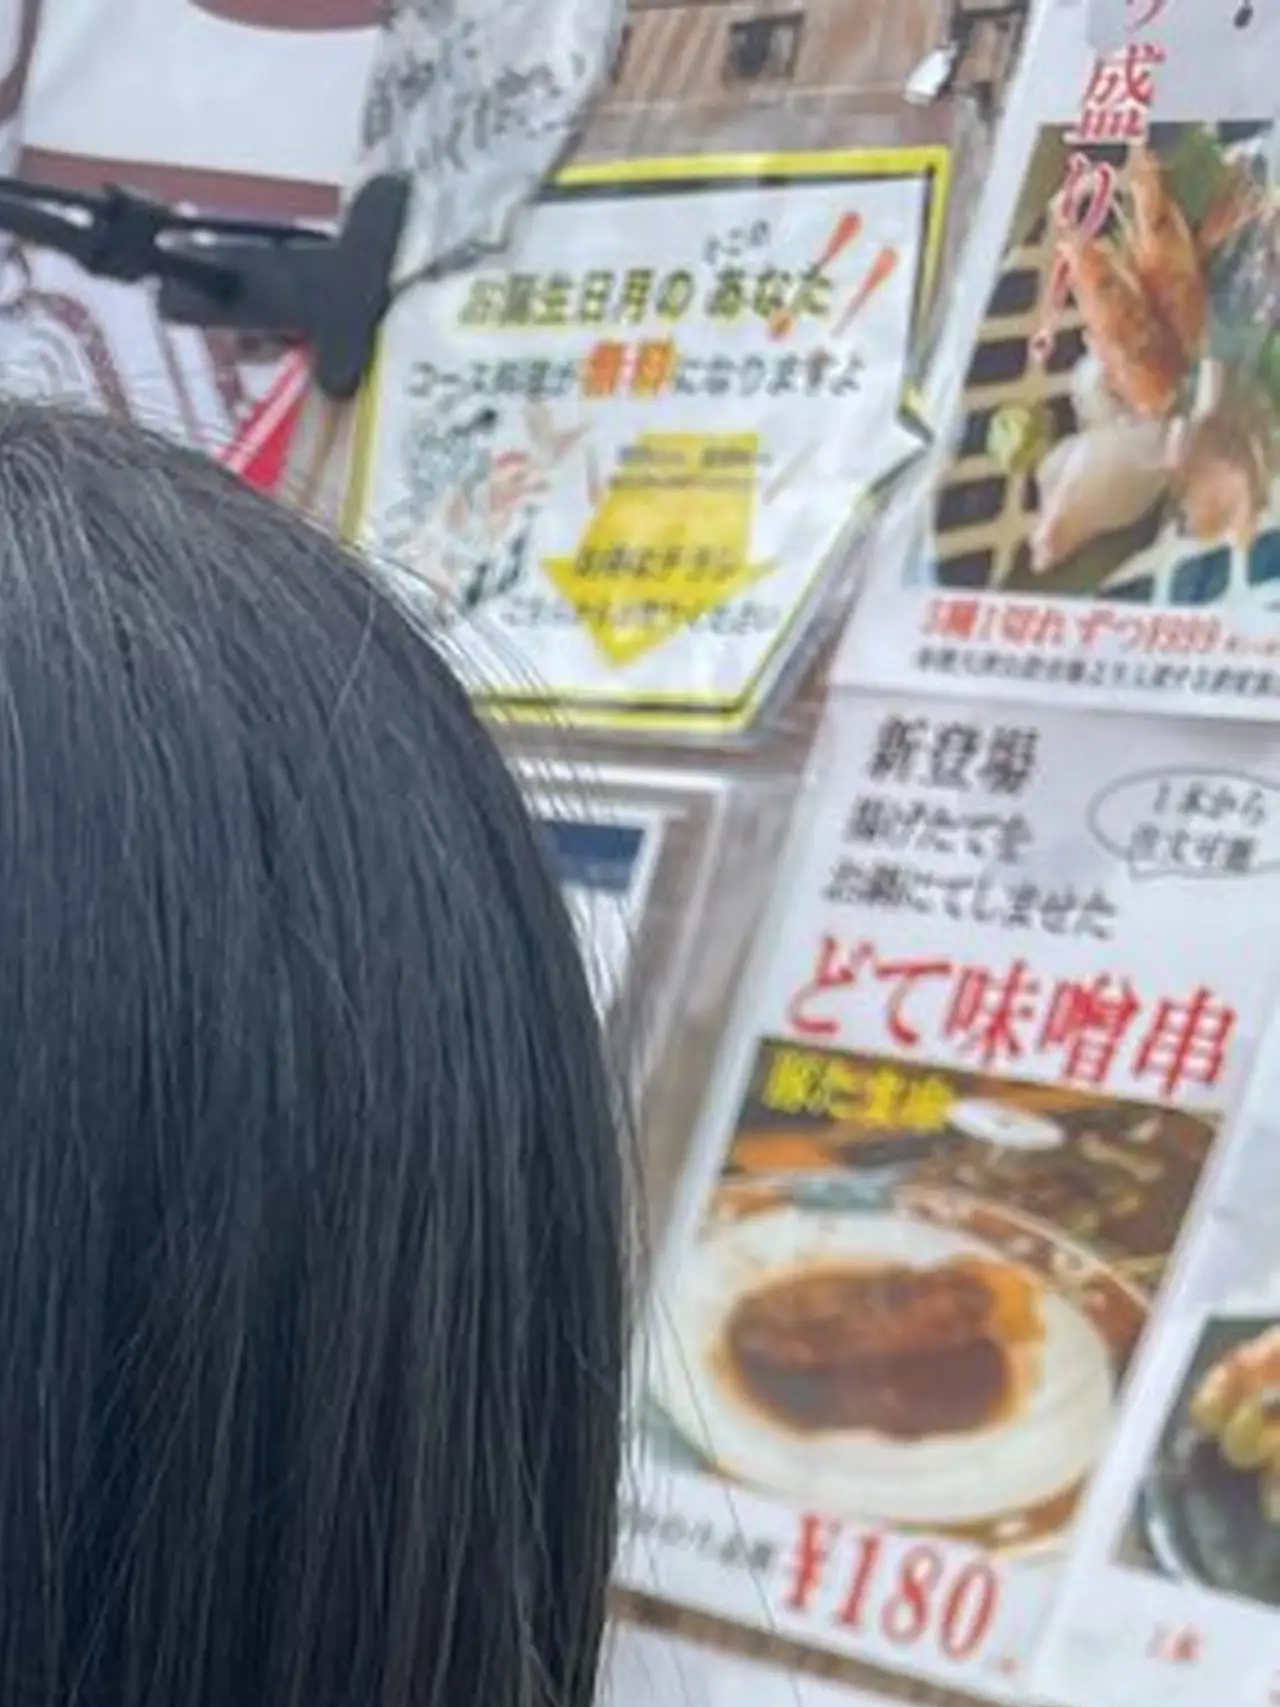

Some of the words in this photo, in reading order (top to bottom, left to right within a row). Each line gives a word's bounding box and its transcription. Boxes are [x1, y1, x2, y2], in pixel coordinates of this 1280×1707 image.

[868, 713, 1039, 796] 新登場
[787, 934, 1237, 1100] どて味噌串
[785, 1511, 1002, 1661] ¥180
